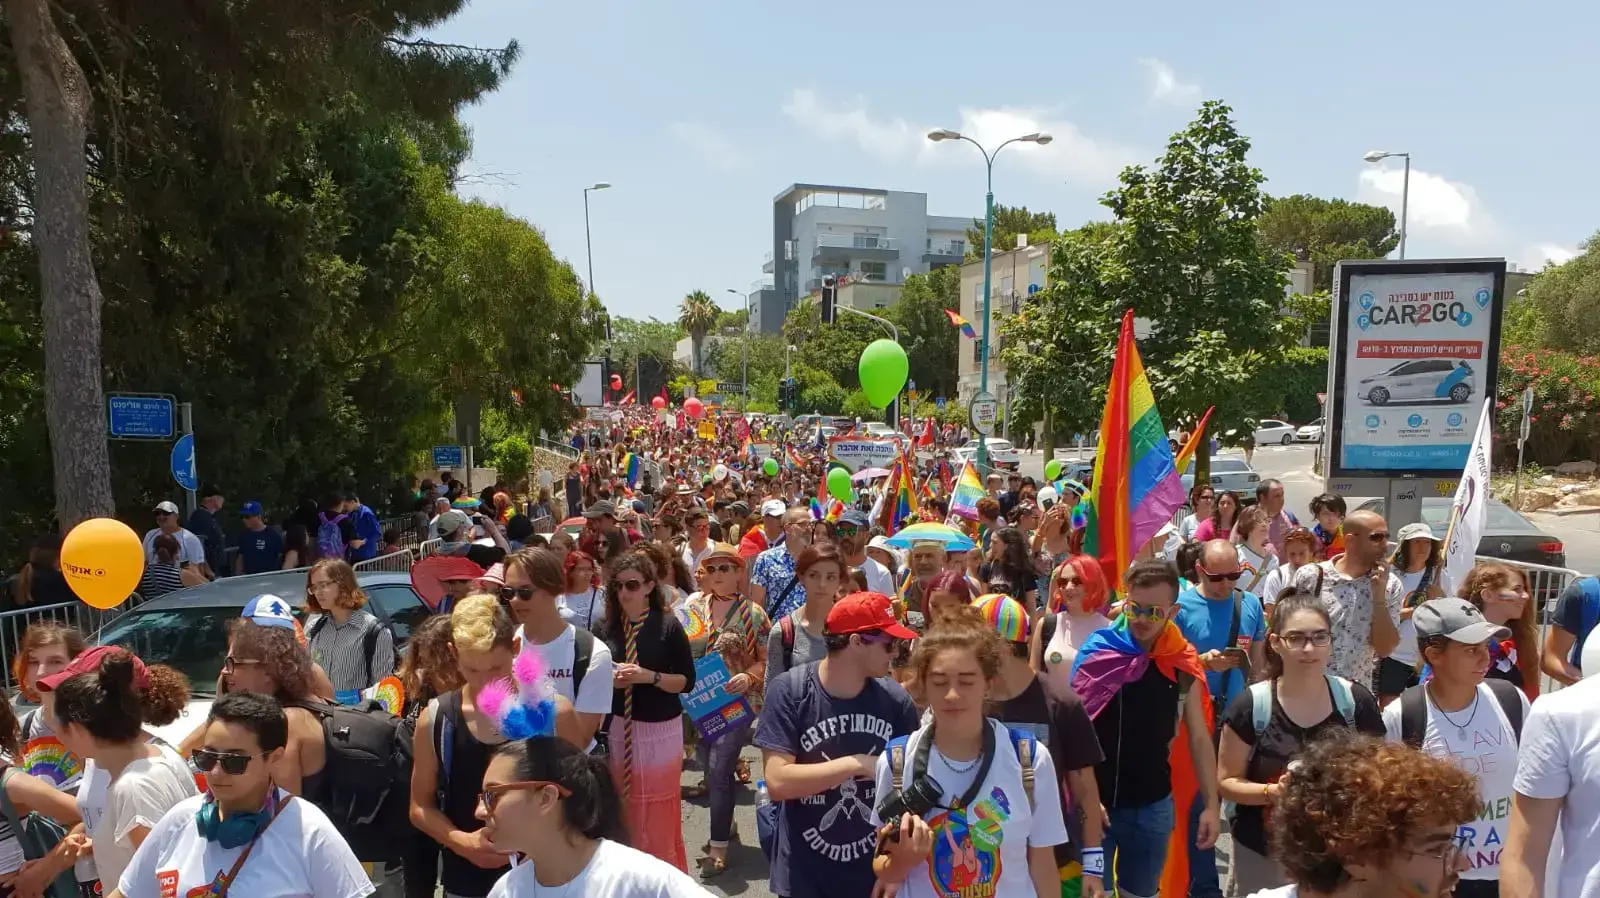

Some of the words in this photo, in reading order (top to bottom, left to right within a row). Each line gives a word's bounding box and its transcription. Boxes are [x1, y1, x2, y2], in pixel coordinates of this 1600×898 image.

[1369, 301, 1464, 326] CAR2GO
[547, 669, 573, 678] NAL
[800, 713, 893, 752] GRYFFINDOR
[1461, 752, 1497, 776] DE
[802, 826, 877, 862] QUIDDITC
